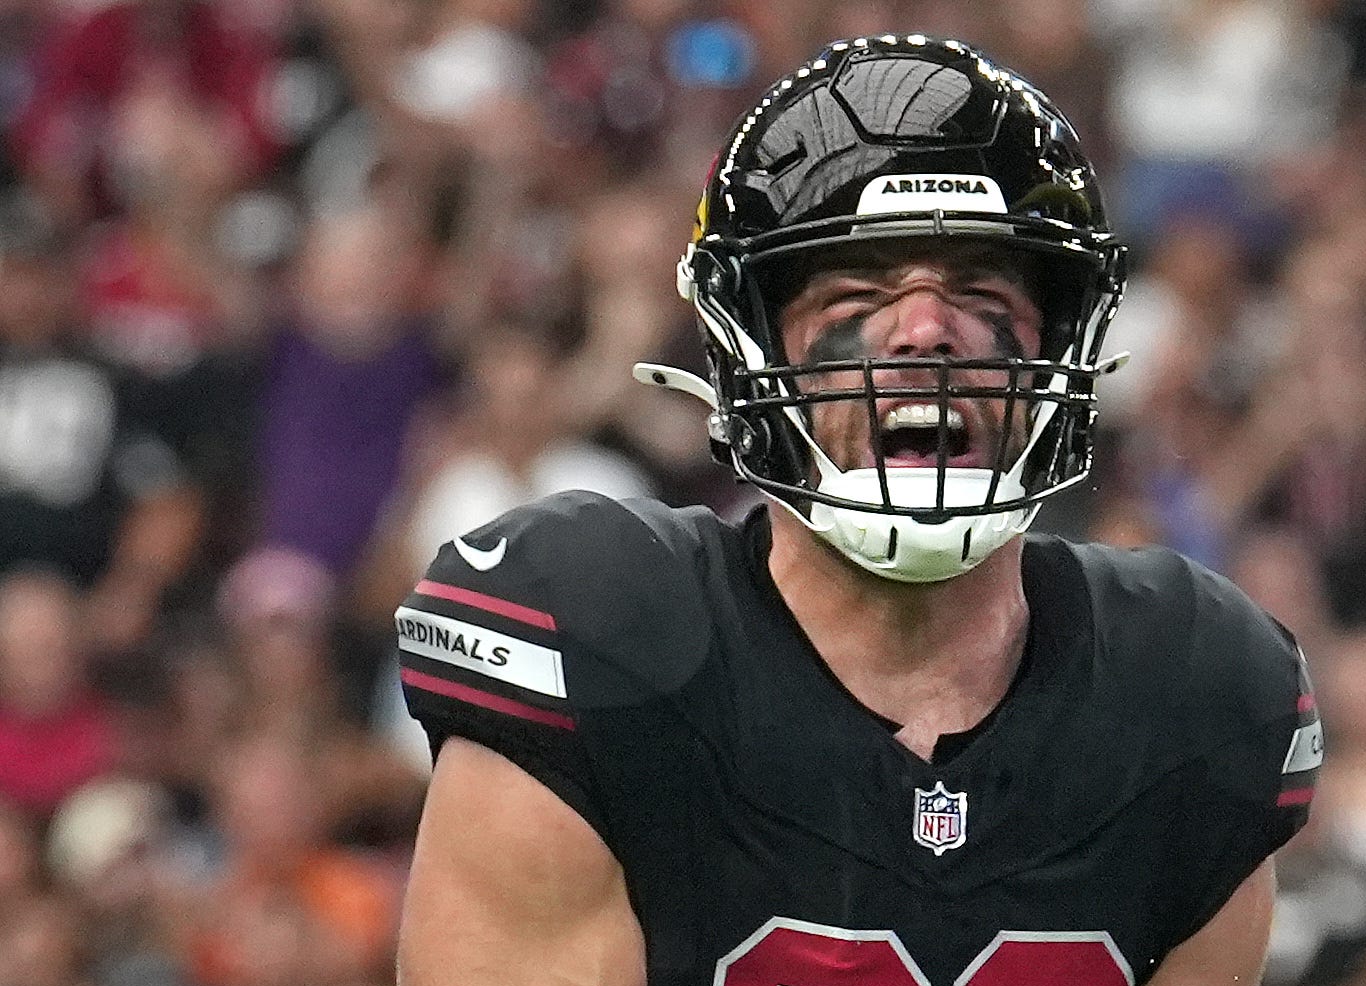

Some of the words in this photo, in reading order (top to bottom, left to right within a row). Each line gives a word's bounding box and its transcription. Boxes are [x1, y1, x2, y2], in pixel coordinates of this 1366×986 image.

[881, 179, 989, 195] ARIZONA
[398, 618, 511, 667] ARDINALS
[922, 814, 957, 842] NFL
